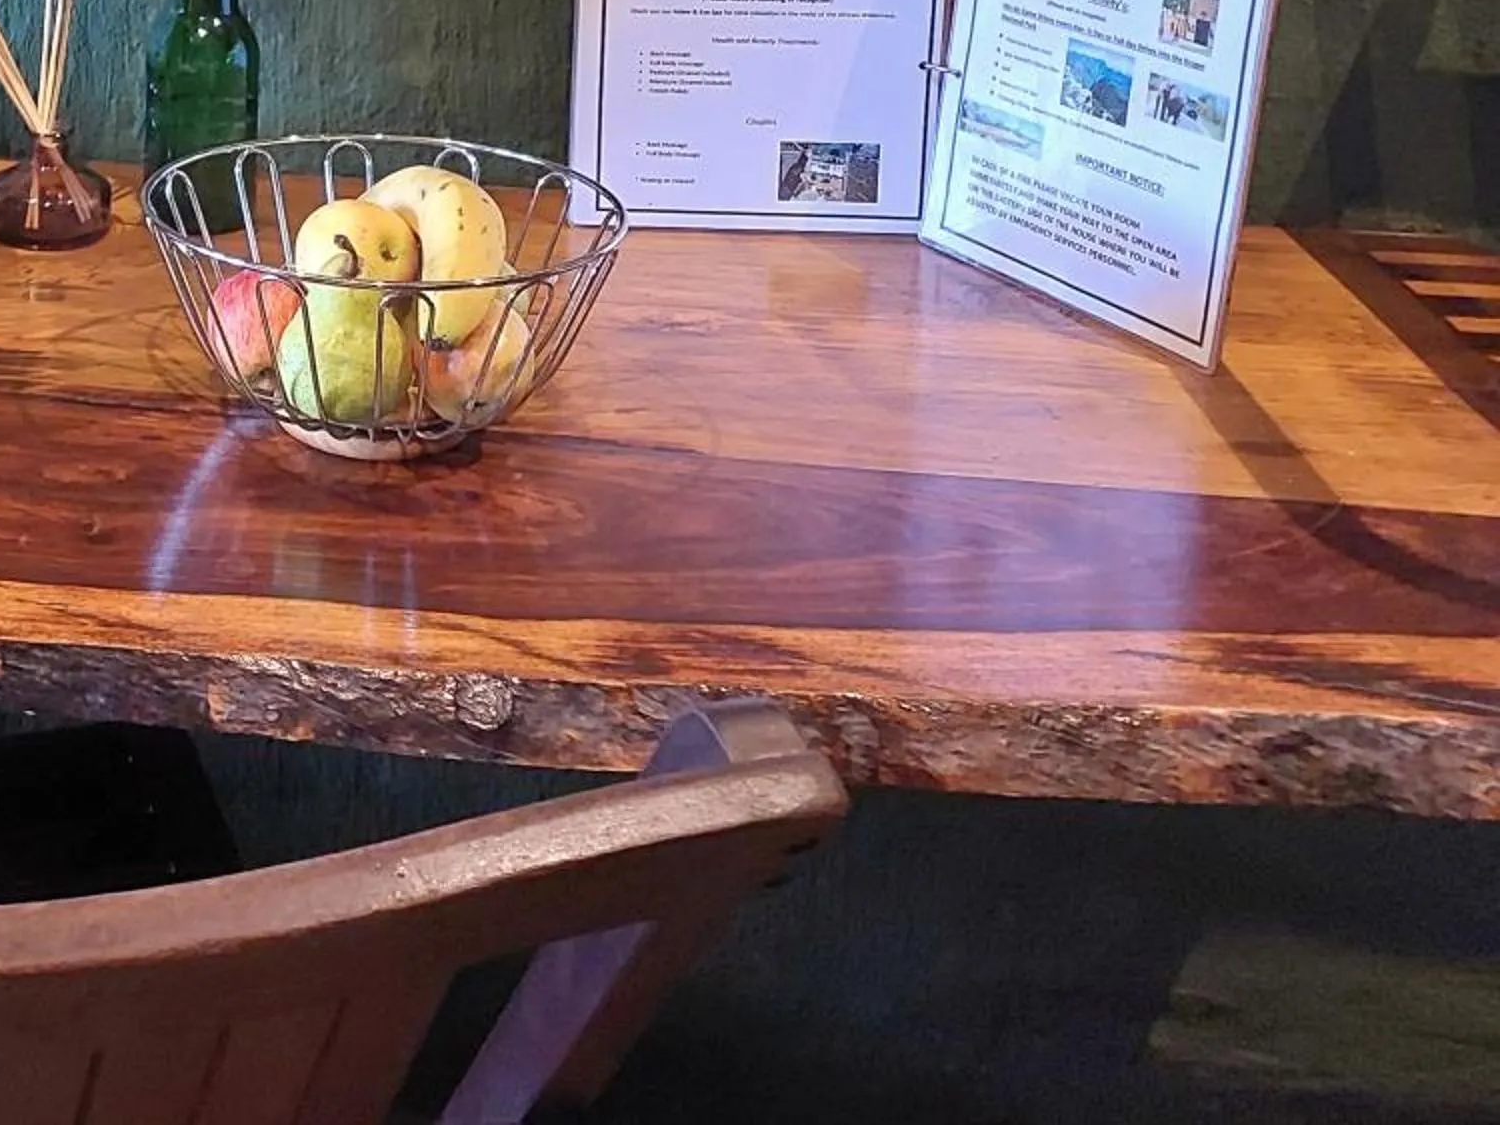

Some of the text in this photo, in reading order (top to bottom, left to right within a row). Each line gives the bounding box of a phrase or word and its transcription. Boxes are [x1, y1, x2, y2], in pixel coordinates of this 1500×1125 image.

[1075, 153, 1129, 182] IMPORTANT
[1032, 178, 1059, 195] PLEASE
[1091, 202, 1113, 219] YOUR
[1113, 212, 1142, 230] ROOM
[1035, 195, 1059, 212] MAKE
[1059, 205, 1080, 220] YOUR
[1081, 214, 1101, 229] WAY
[1115, 227, 1129, 242] THE
[1131, 235, 1155, 252] OPEN
[1155, 245, 1178, 261] AREA
[1008, 214, 1053, 238] EMERGENCY
[1053, 233, 1087, 254] SERVICES
[1071, 226, 1097, 244] HOUSE
[1098, 237, 1128, 256] WHERE
[1128, 250, 1147, 264] YOU
[1148, 258, 1168, 274] WILL
[1169, 267, 1181, 279] BE
